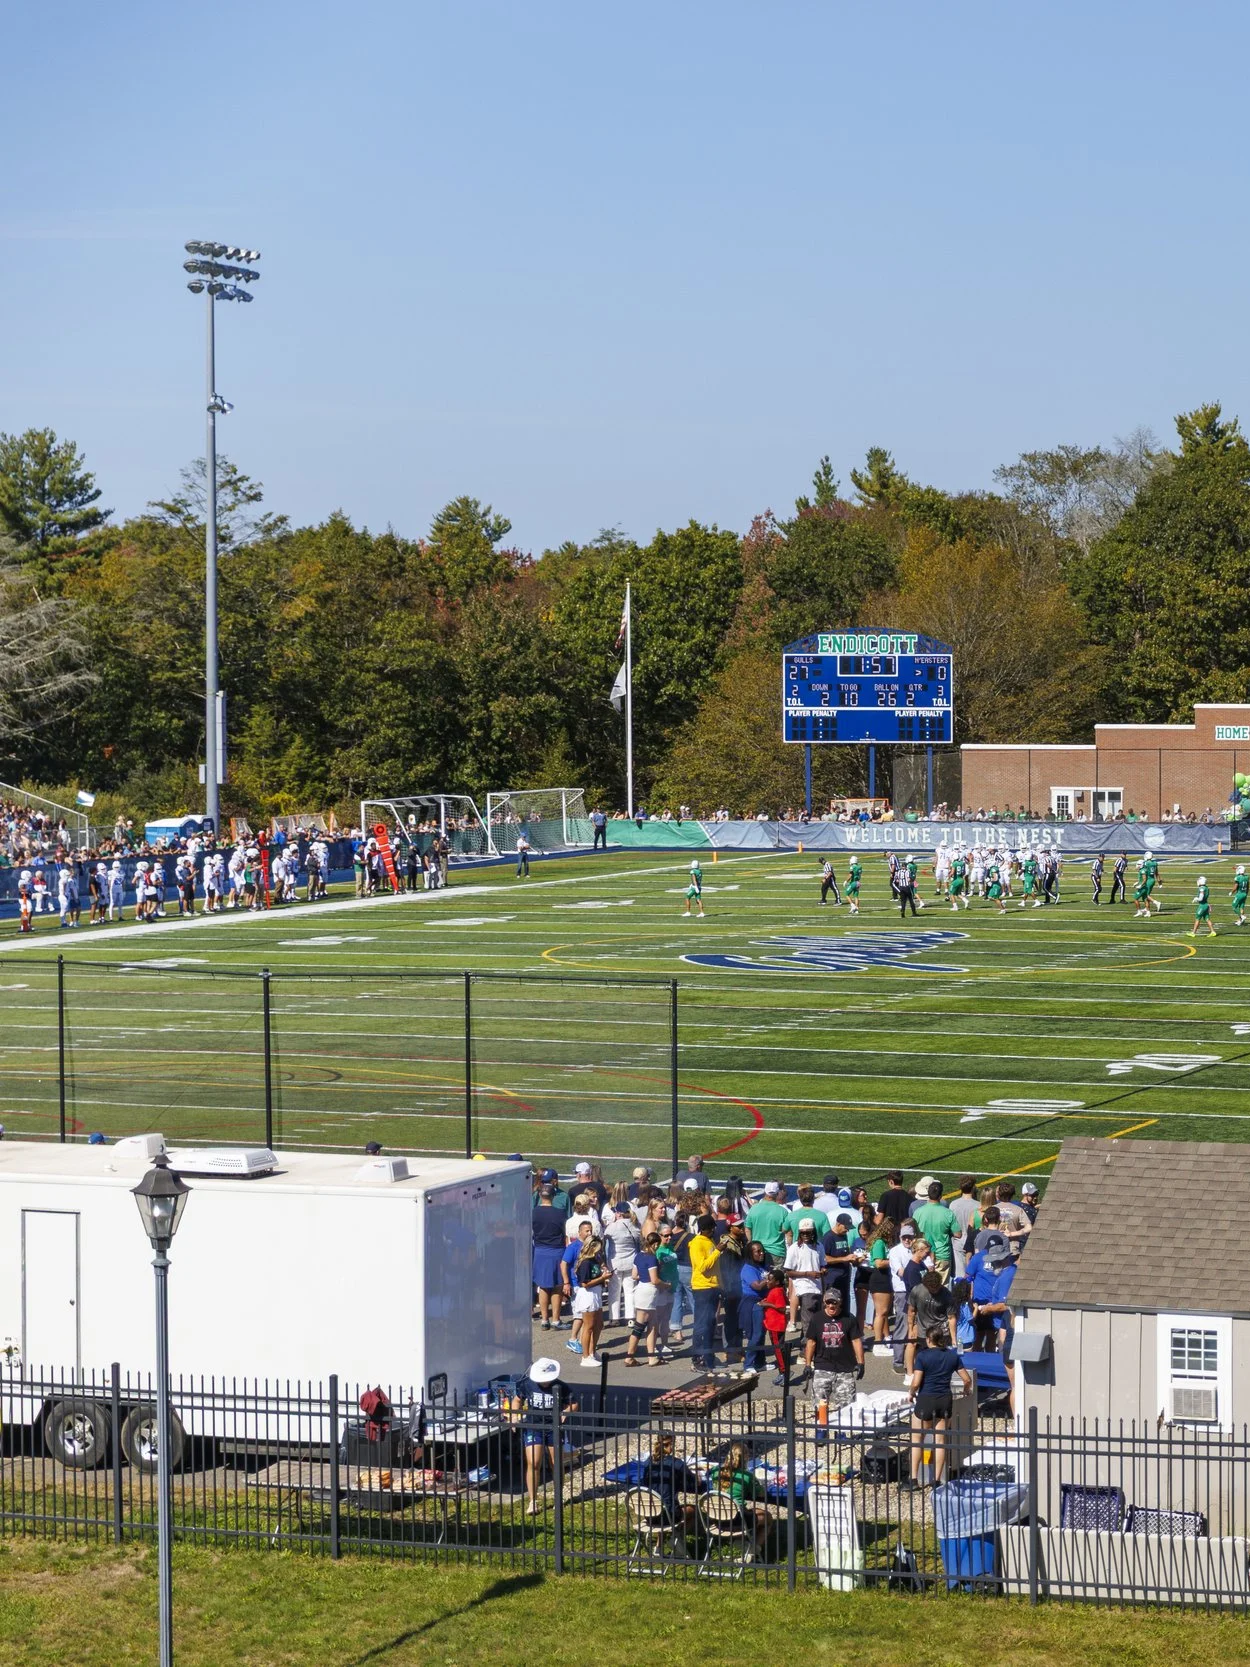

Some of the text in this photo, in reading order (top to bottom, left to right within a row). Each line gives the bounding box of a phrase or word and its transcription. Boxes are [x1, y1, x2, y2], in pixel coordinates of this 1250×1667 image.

[817, 634, 918, 654] ENDICOTT
[862, 657, 895, 674] 1:57
[789, 666, 808, 680] 27
[938, 666, 946, 680] 0
[792, 685, 799, 696] 2
[937, 685, 944, 697] 3
[821, 692, 830, 706] 2
[844, 692, 859, 706] 10
[877, 692, 897, 706] 26
[906, 692, 915, 706] 2
[932, 698, 950, 706] T.O.L.
[1215, 726, 1249, 740] HOME
[845, 827, 1065, 845] WELCOME TO THE NEST
[1105, 1053, 1223, 1072] 20
